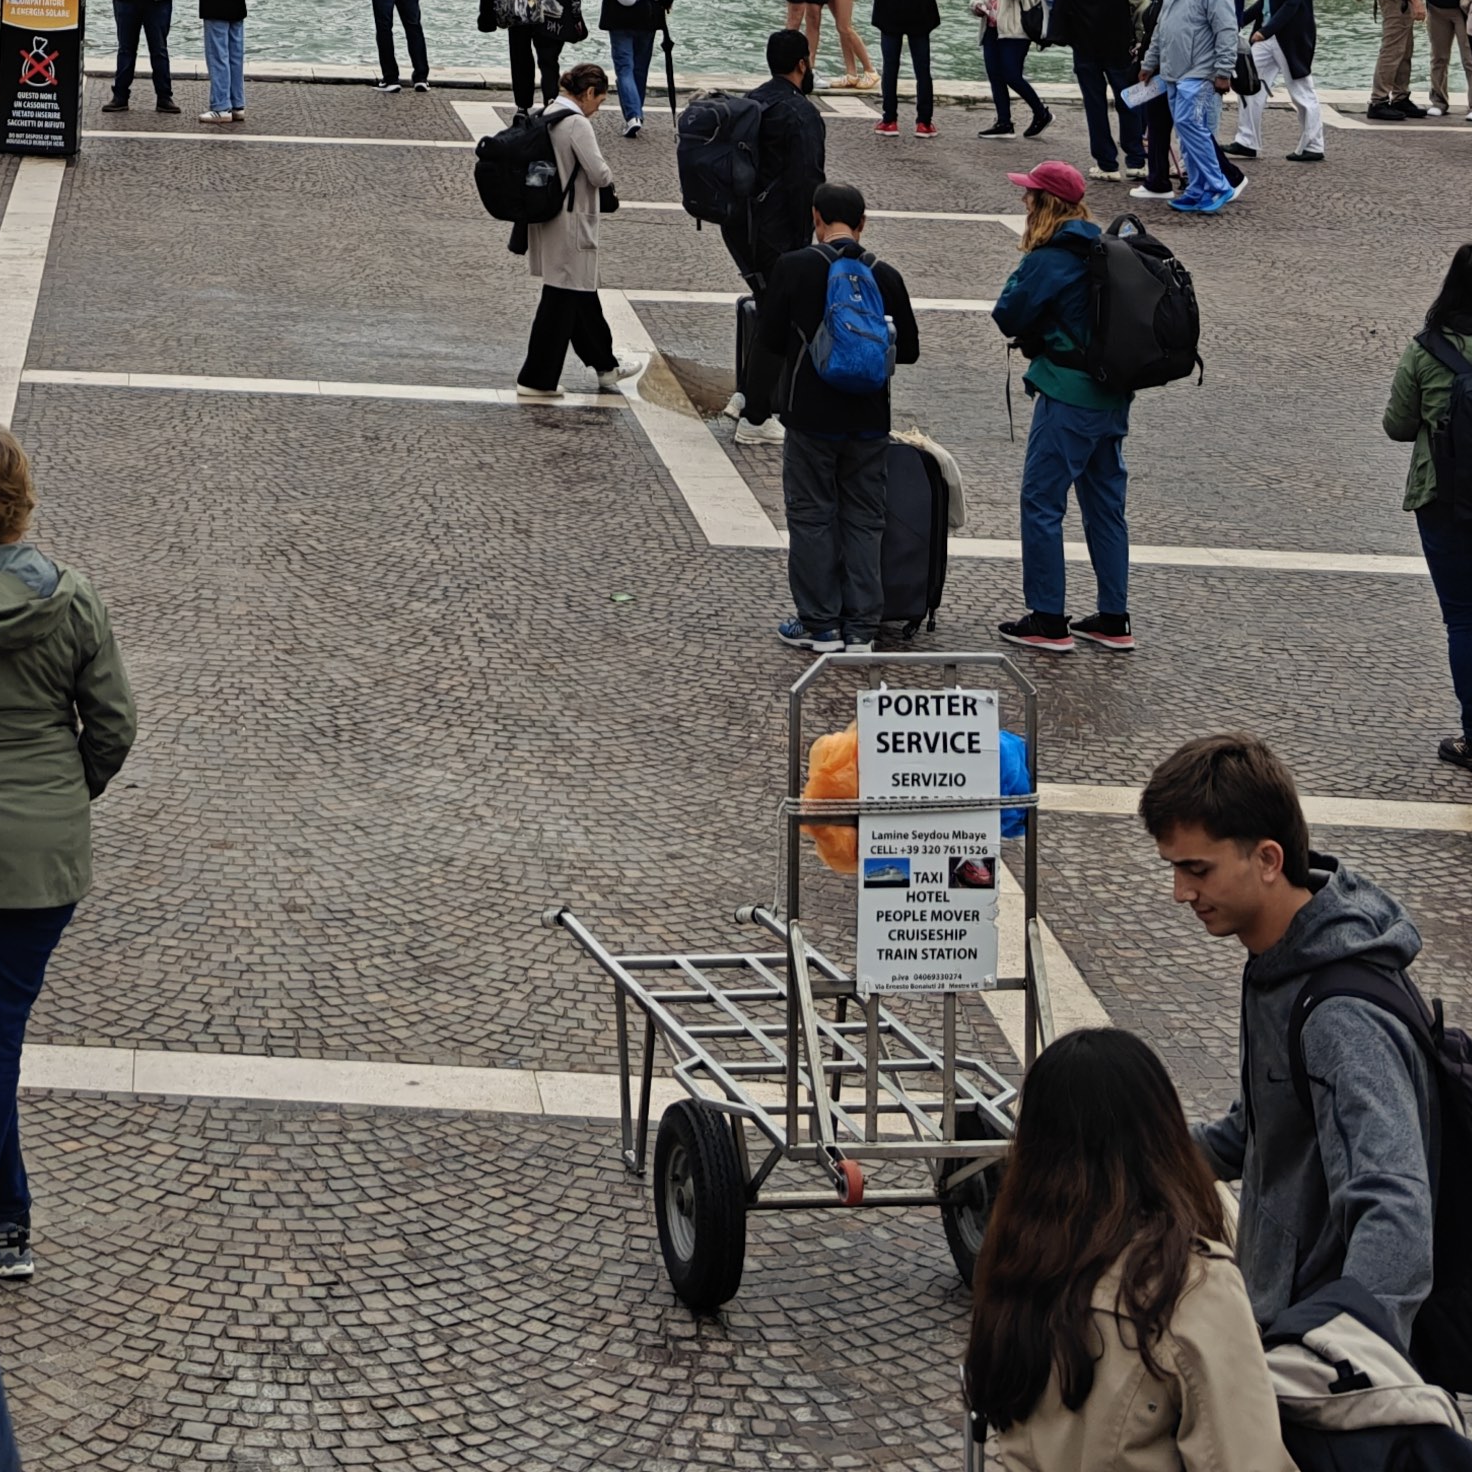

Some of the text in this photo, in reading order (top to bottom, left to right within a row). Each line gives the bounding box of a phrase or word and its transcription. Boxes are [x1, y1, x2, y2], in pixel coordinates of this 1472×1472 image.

[17, 8, 44, 16] ENERGIA
[45, 9, 70, 18] SOLARE
[18, 92, 38, 100] QUESTO
[40, 92, 52, 100] NON
[12, 110, 60, 119] VIETATO INSERIRE
[7, 119, 36, 127] SACCHETTI
[44, 120, 65, 128] RIFIUTI
[878, 694, 978, 716] PORTER
[876, 731, 981, 754] SERVICE
[891, 772, 966, 788] SERVIZIO
[872, 830, 987, 842] Lamine Seydou Mbaye
[870, 845, 988, 855] CELL: +39 320 7611526
[914, 872, 942, 884] TAXI
[906, 891, 950, 903] HOTEL
[876, 910, 980, 922] PEOPLE MOVER
[888, 929, 967, 941] CRUISESHIP
[877, 948, 978, 960] TRAIN STATION
[892, 974, 909, 982] p.iva
